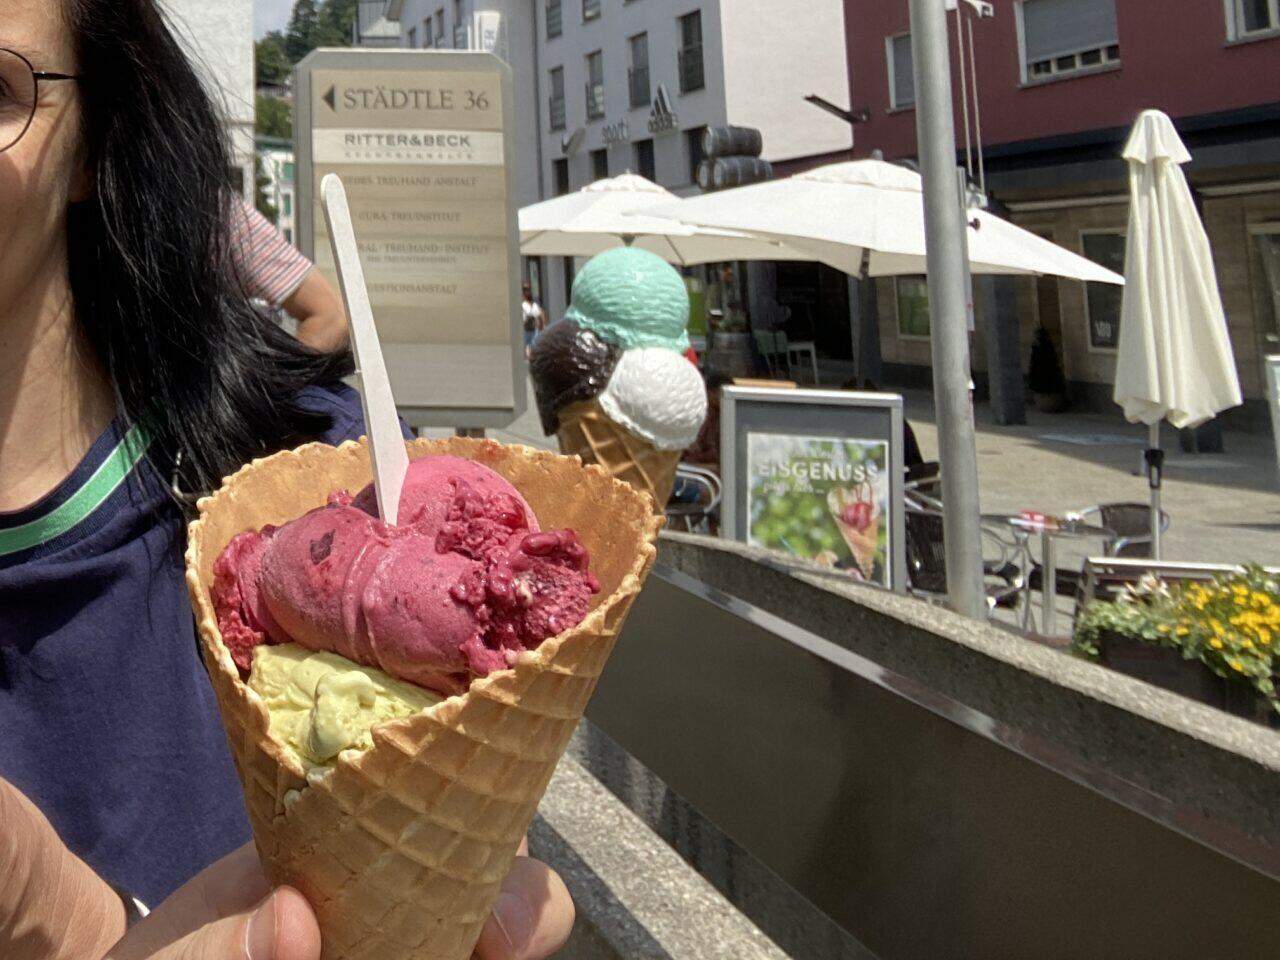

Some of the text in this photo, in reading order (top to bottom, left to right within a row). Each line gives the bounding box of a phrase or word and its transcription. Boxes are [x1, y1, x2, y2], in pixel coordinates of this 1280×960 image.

[343, 85, 490, 111] STÄDTLE 36
[344, 133, 471, 147] RITTER&BECK
[758, 460, 879, 482] EISGENUSS
